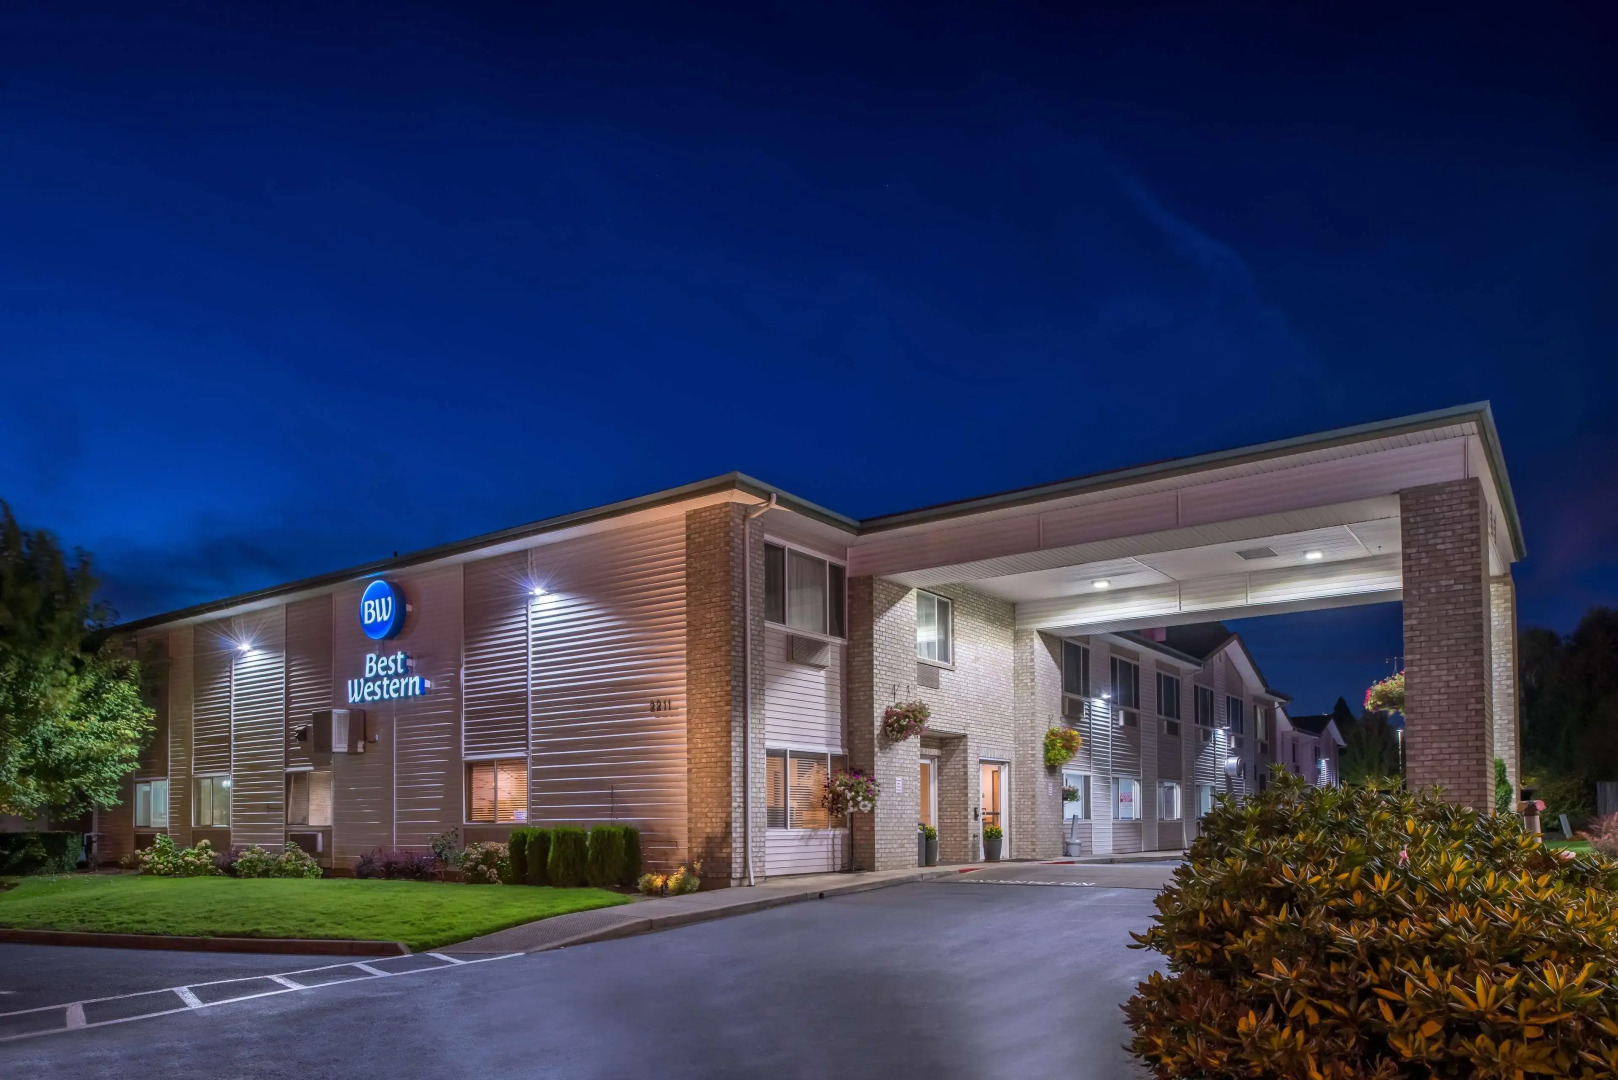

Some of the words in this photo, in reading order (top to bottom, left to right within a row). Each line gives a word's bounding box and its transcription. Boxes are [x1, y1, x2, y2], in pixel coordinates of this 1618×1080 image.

[364, 596, 392, 624] BW
[365, 651, 404, 678] Best
[348, 675, 420, 703] Western
[650, 699, 671, 712] 2211
